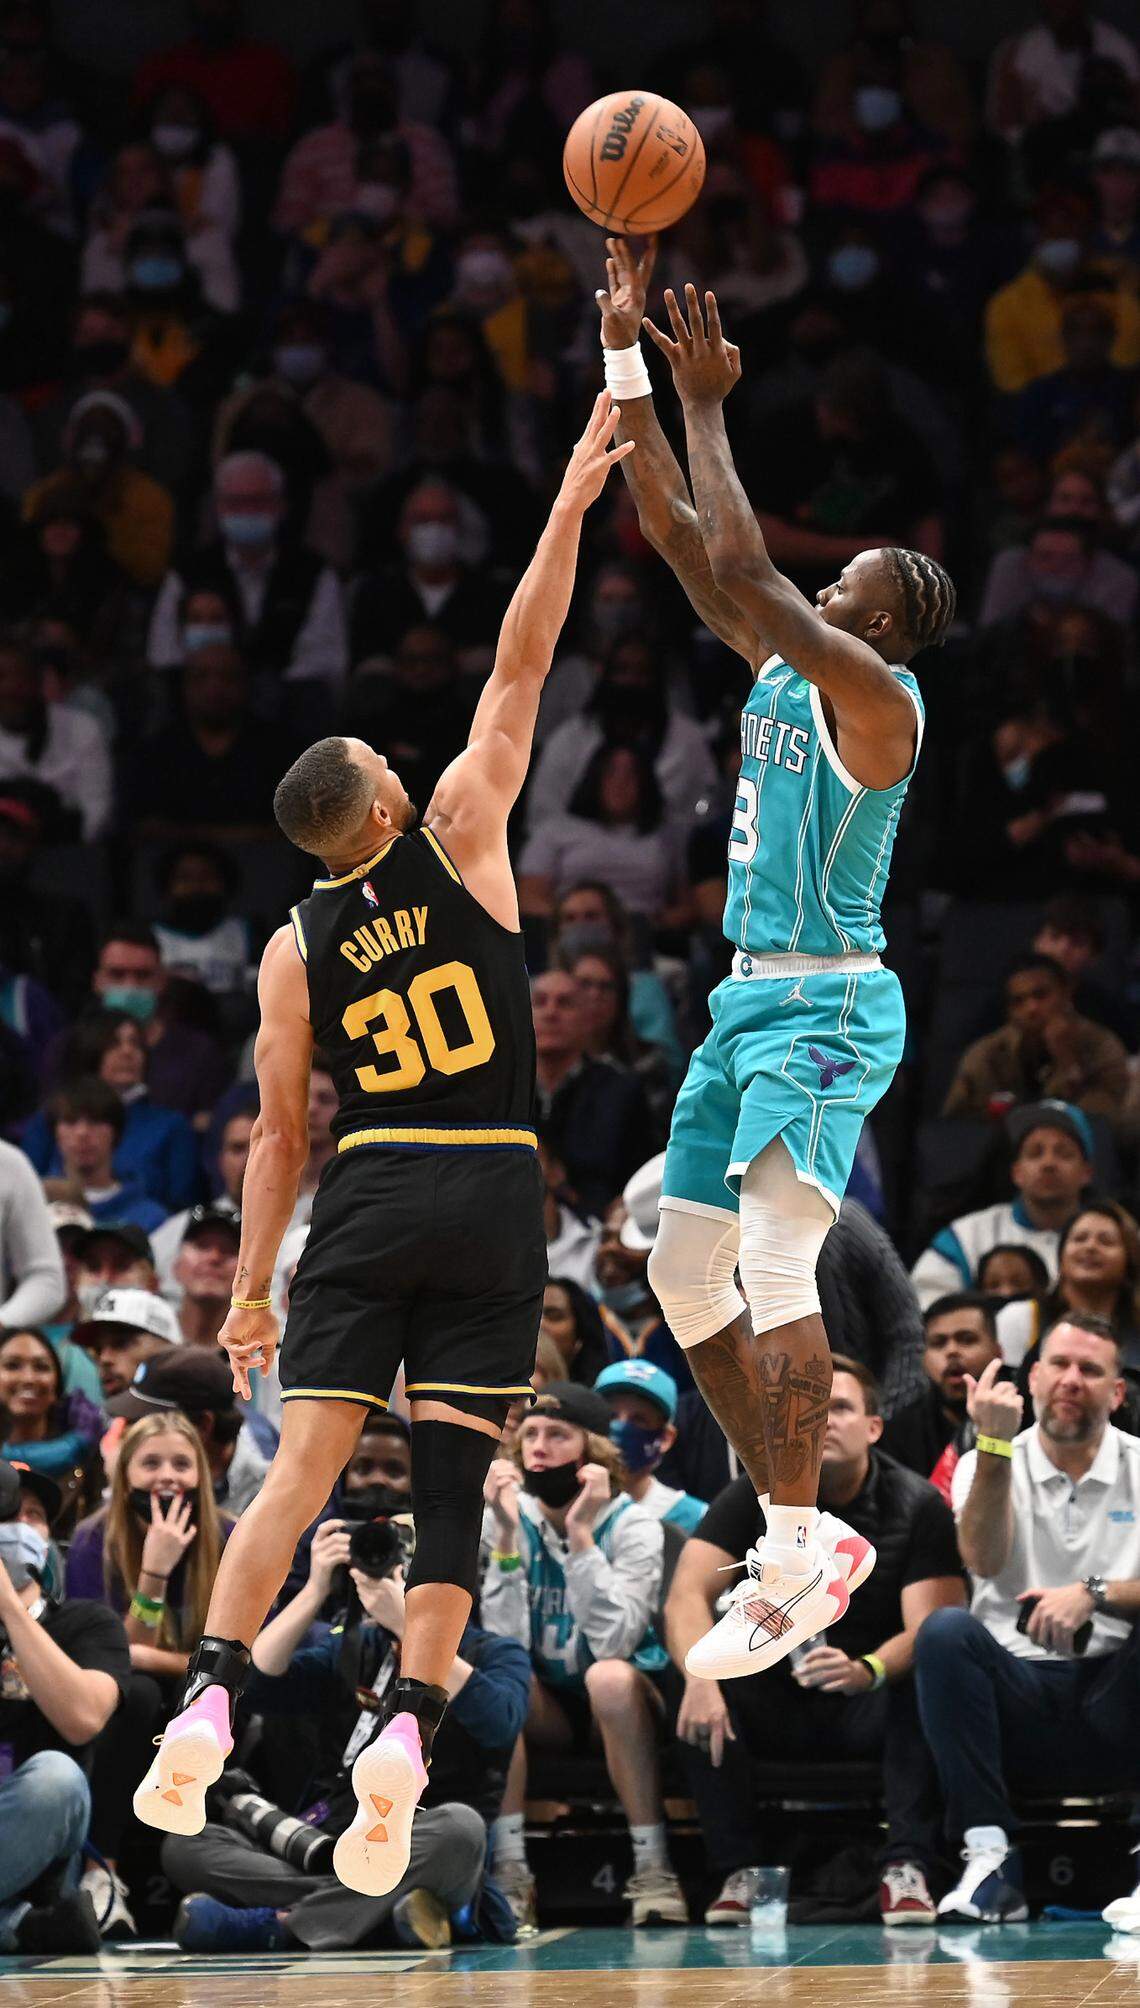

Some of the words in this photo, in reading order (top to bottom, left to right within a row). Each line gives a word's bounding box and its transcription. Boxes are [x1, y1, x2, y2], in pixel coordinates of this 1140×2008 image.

[601, 97, 645, 161] Wilso
[740, 711, 810, 775] RNETS
[728, 776, 760, 864] 3
[340, 906, 428, 973] CURRY
[341, 960, 496, 1093] 30
[592, 1864, 615, 1893] 4
[1049, 1855, 1074, 1886] 6
